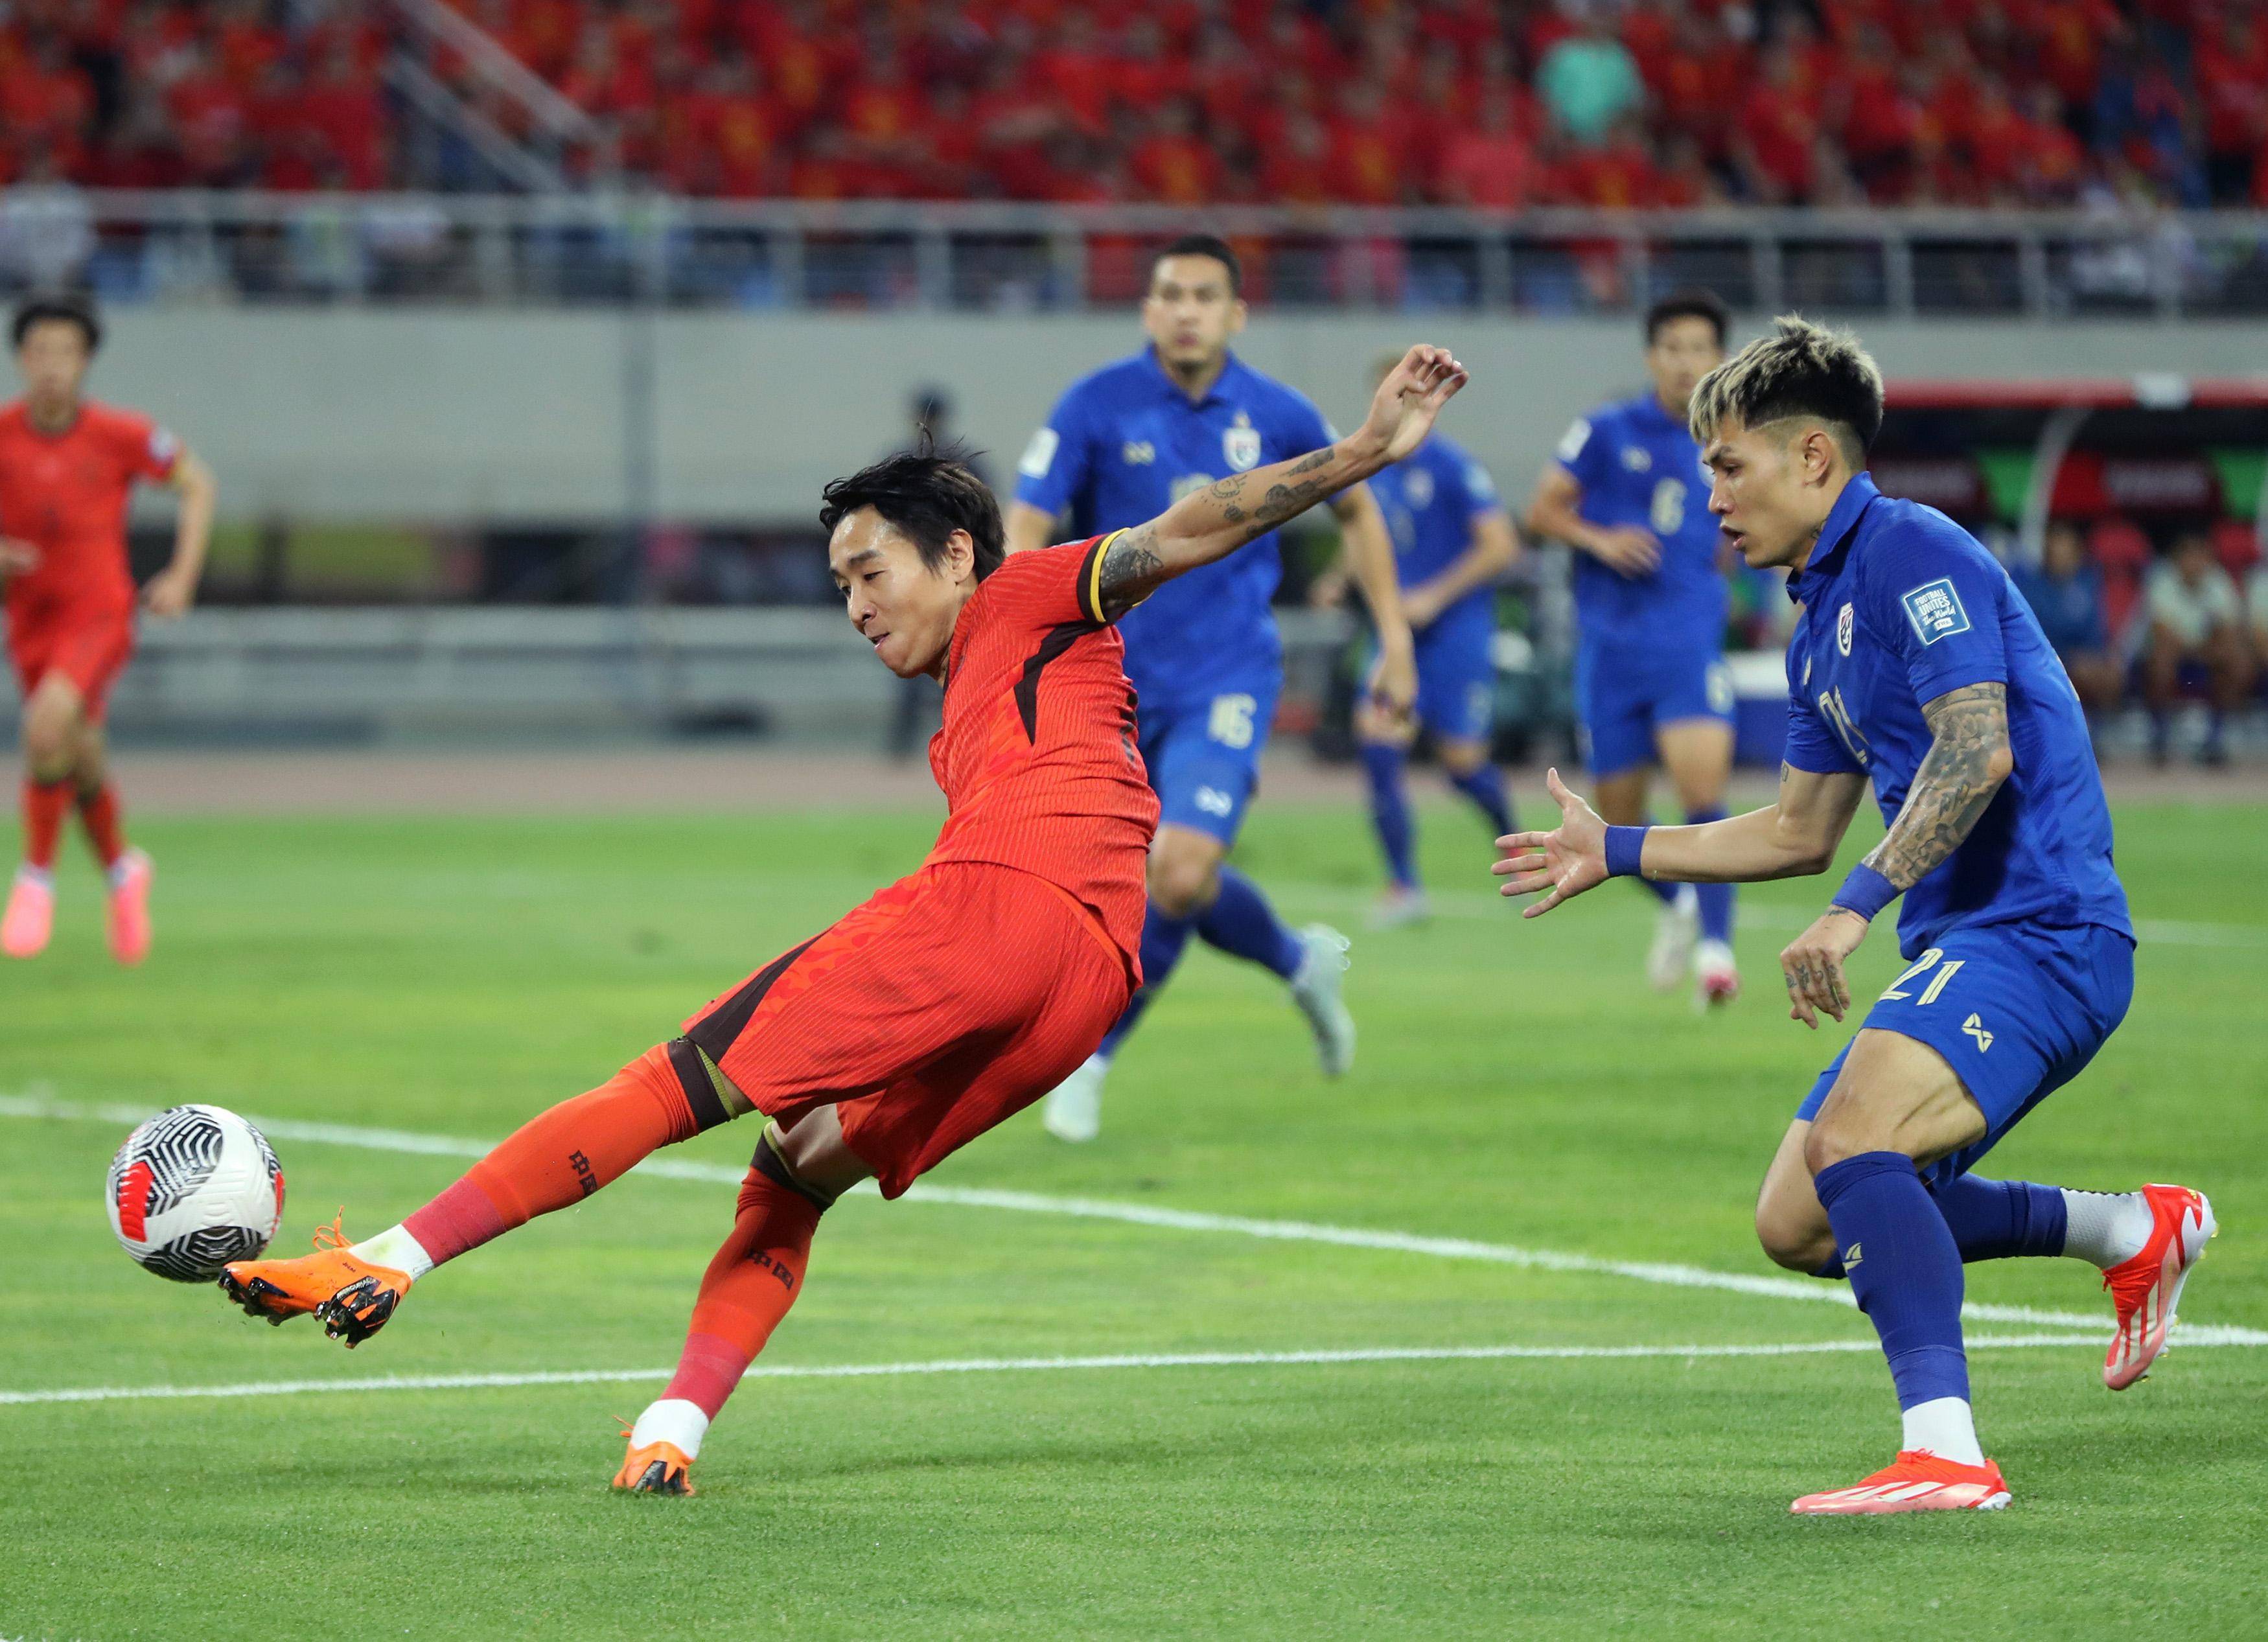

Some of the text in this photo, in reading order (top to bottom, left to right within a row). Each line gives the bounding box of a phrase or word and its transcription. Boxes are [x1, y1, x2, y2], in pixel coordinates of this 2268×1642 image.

[1651, 478, 1687, 535] 6
[1914, 588, 1947, 607] FOOTBALL
[1919, 596, 1950, 616] UNITES
[1934, 605, 1956, 619] World
[1209, 693, 1257, 749] 16
[1879, 947, 1966, 1006] 21
[568, 1149, 597, 1196] 中国
[745, 1249, 794, 1291] 中国
